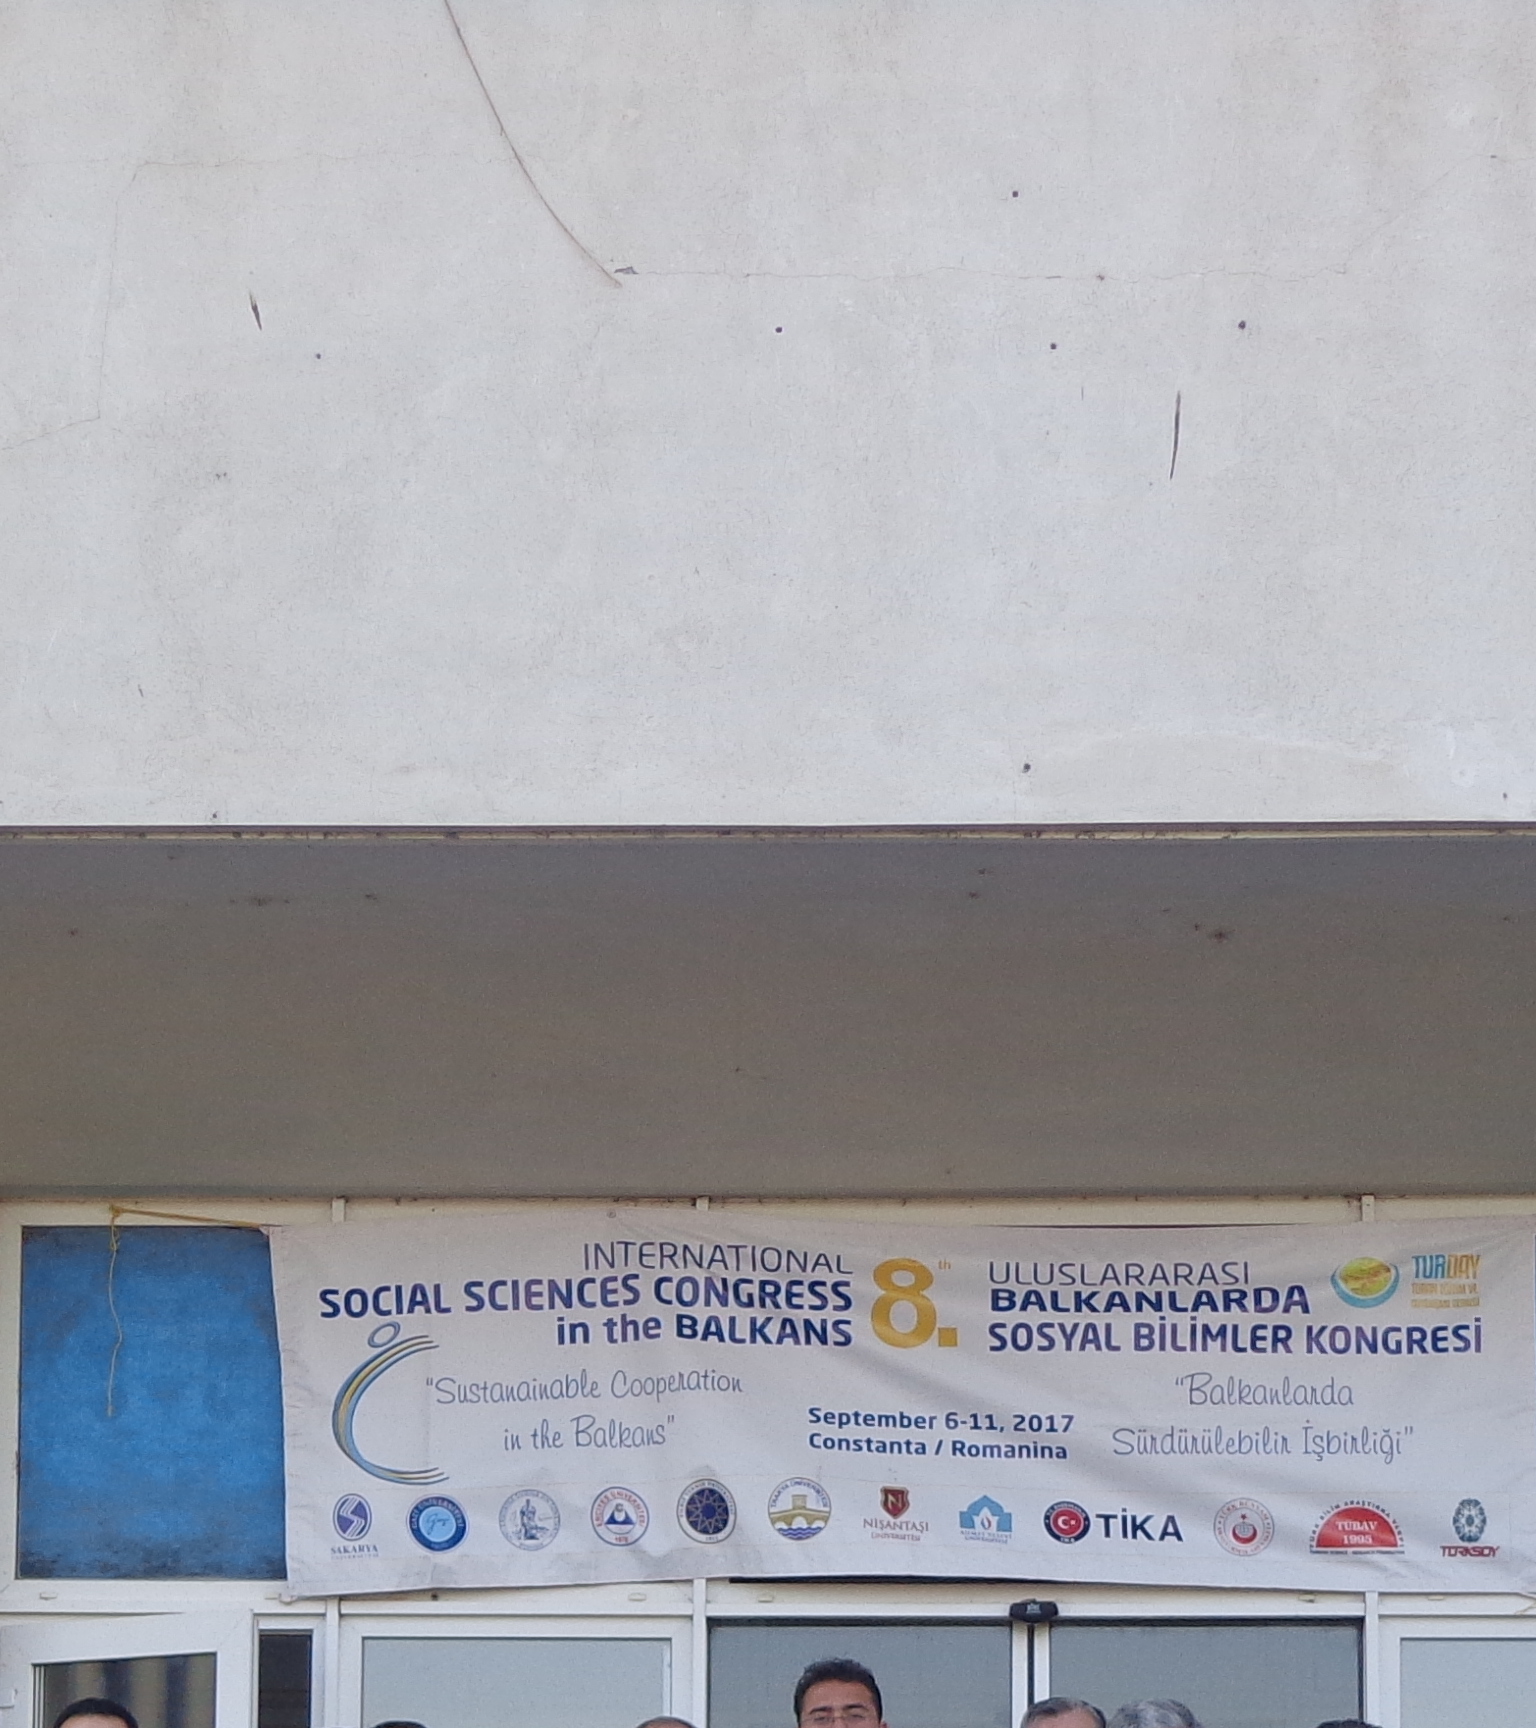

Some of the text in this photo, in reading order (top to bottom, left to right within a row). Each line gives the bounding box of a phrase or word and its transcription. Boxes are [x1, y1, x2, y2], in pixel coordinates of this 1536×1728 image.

[583, 1240, 855, 1275] INTERNATIONAL
[988, 1260, 1250, 1287] ULUSLARARASI
[318, 1273, 854, 1319] SOCIAL SCIENCES CONGRESS
[989, 1284, 1311, 1315] BALKANLARDA
[556, 1313, 854, 1347] in the BALKANS
[987, 1315, 1483, 1355] SOSYAL BİLİMLER KONGRESİ
[610, 1369, 744, 1403] Cooperation
[503, 1428, 522, 1451] in
[530, 1418, 565, 1450] the
[807, 1407, 1075, 1434] September 6-11, 2017
[807, 1432, 1069, 1460] Constanta / Romanina
[1111, 1425, 1292, 1456] Sürdürülebilir
[1095, 1507, 1185, 1543] TİKA
[1342, 1534, 1374, 1545] 1995
